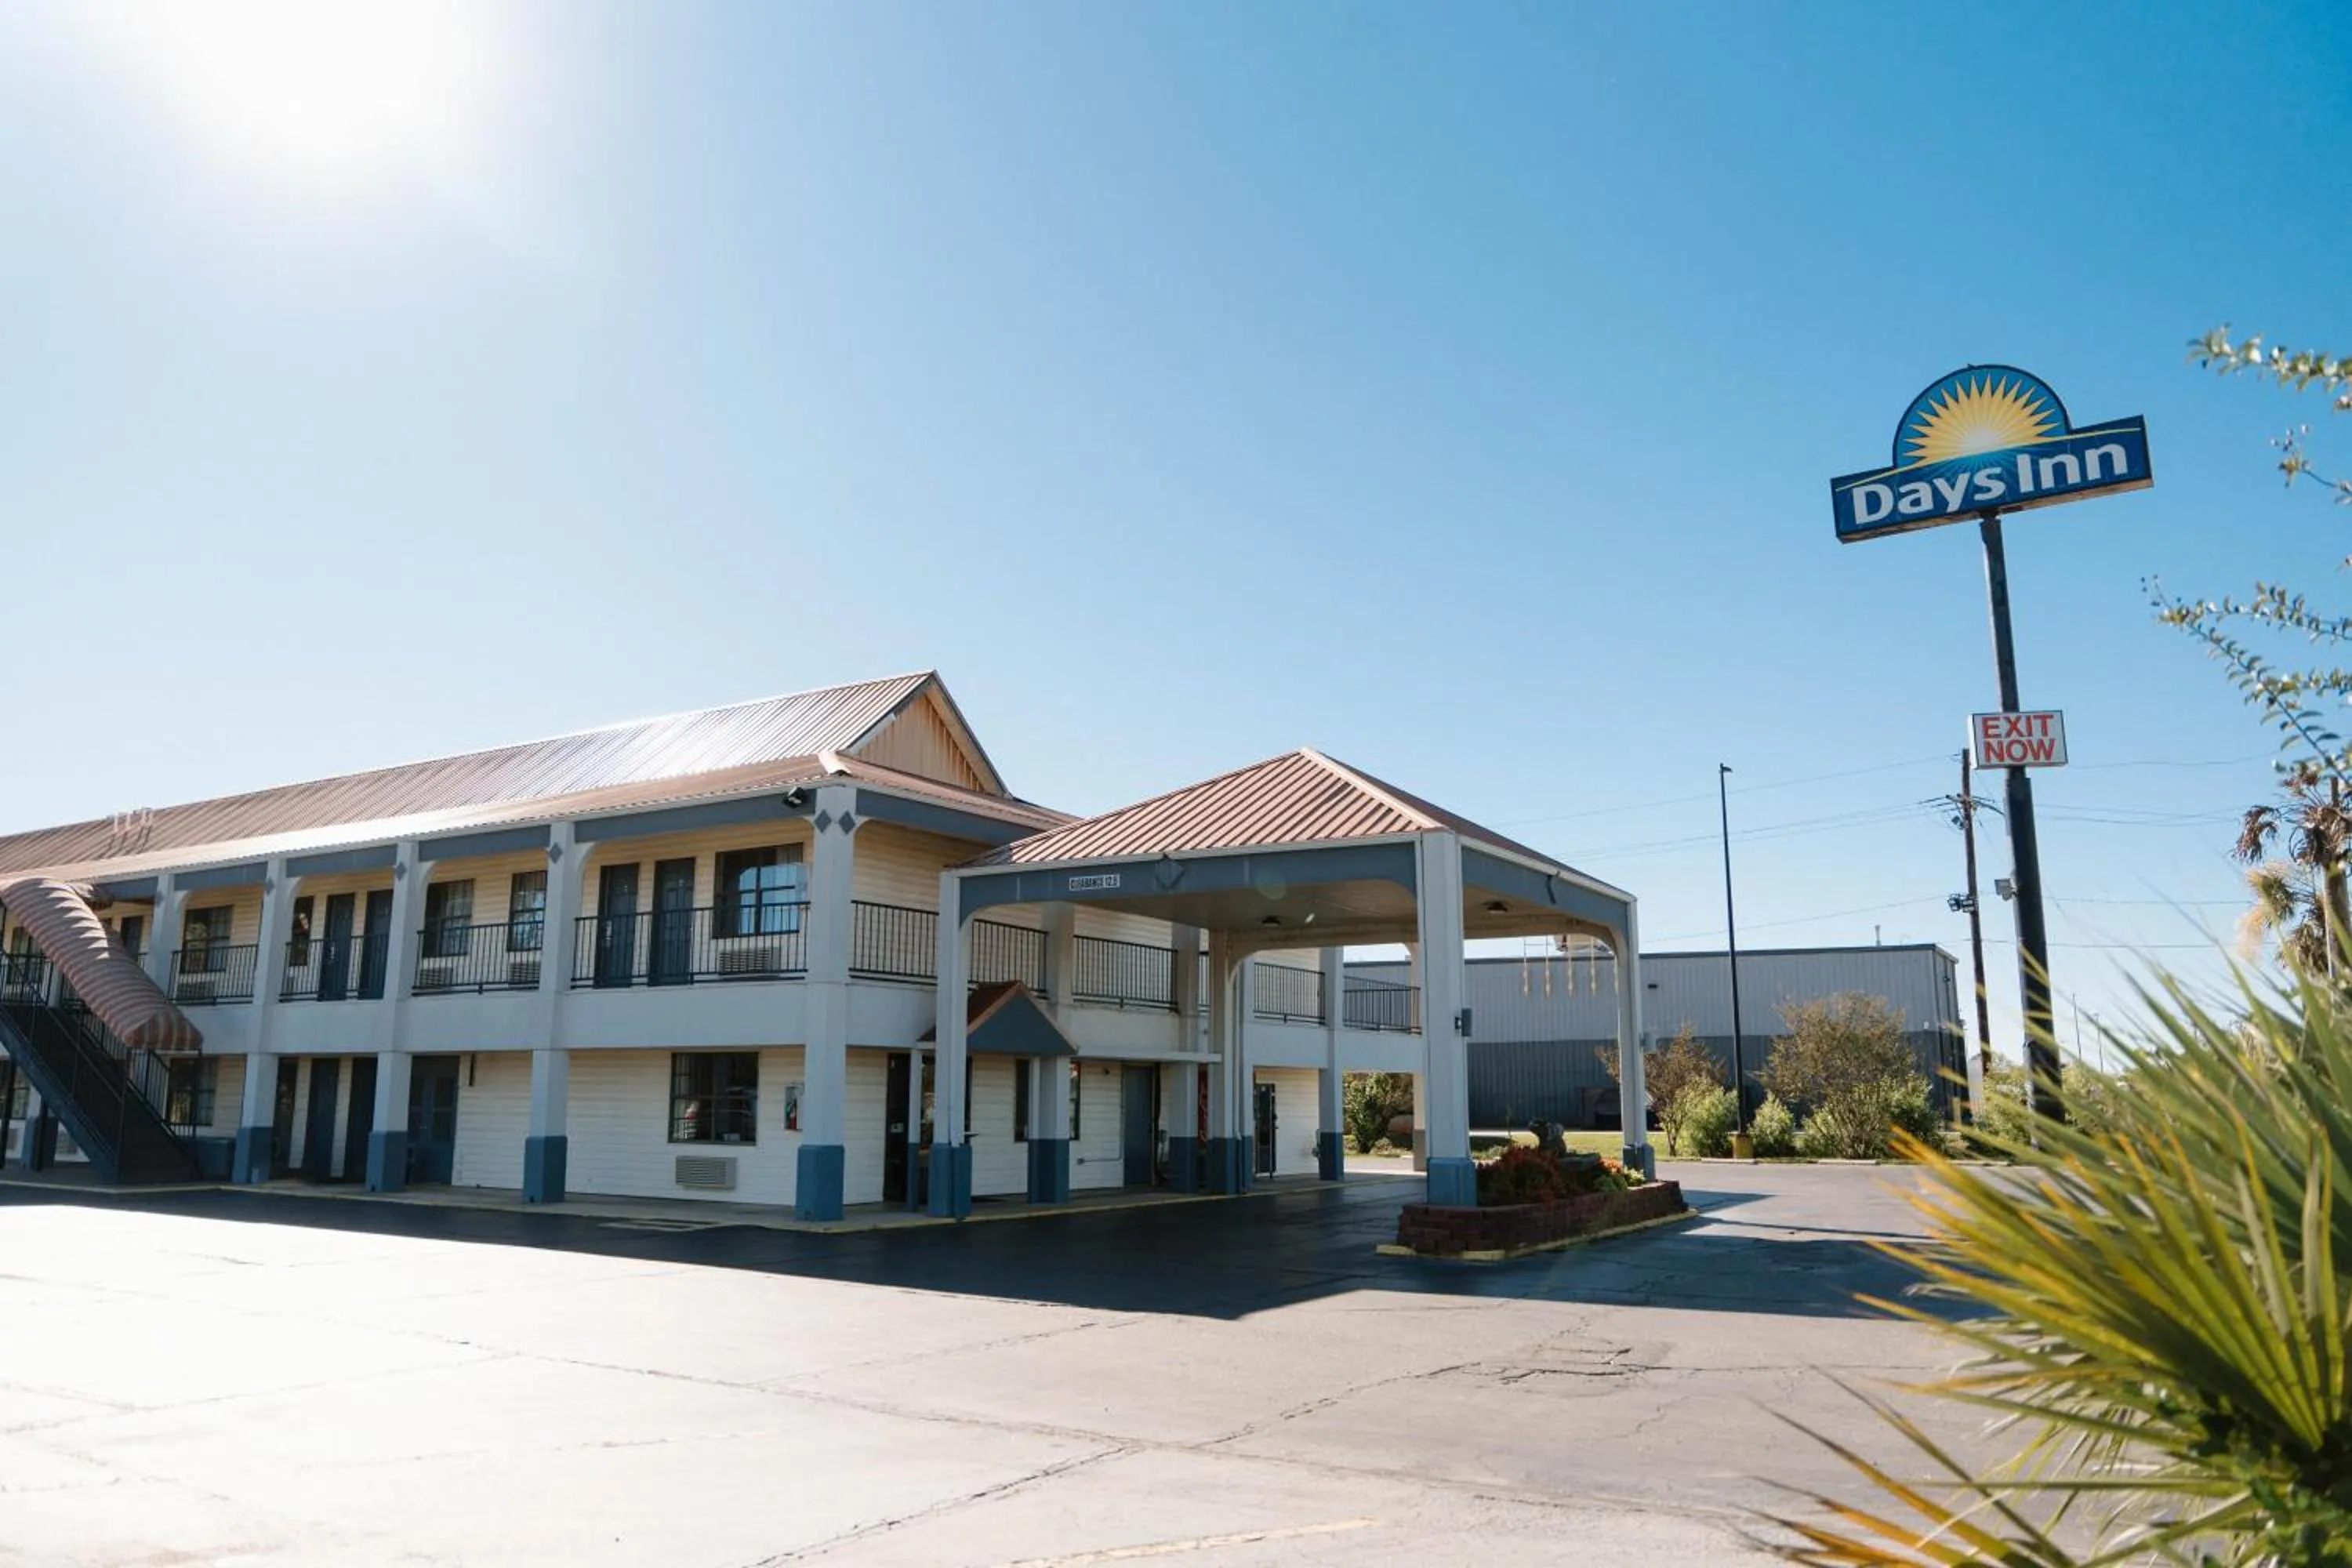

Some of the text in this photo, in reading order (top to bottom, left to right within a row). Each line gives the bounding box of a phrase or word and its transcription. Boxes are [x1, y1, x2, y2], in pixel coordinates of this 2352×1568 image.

[1852, 443, 2128, 524] Days Inn
[1981, 714, 2053, 739] EXIT
[1984, 739, 2056, 763] NOW
